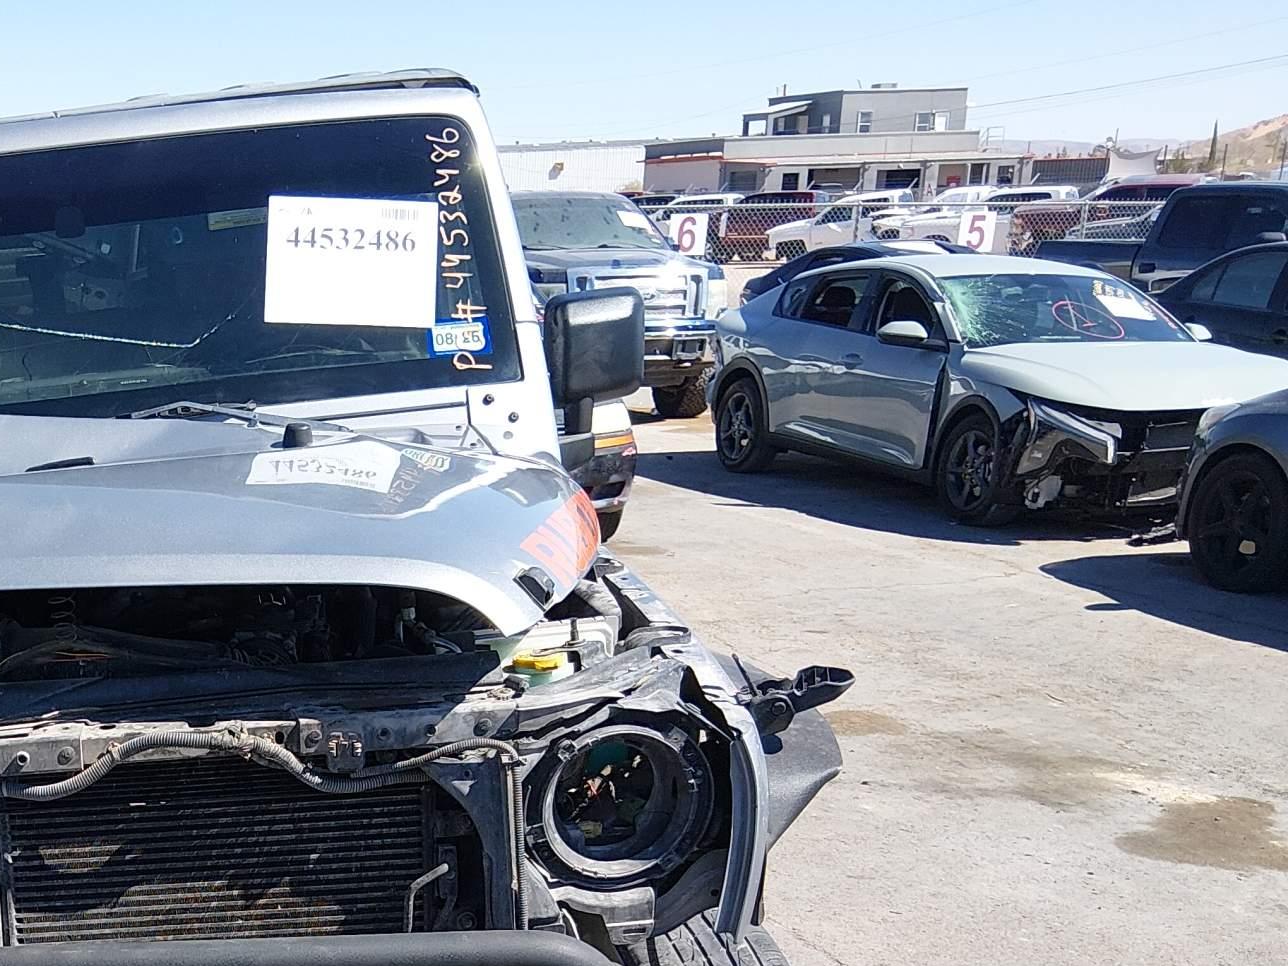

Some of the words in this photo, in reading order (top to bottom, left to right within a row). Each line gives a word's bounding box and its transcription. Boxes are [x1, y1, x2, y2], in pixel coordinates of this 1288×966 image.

[426, 127, 475, 289] 44532486
[285, 226, 417, 252] 44532486
[677, 215, 697, 252] 6
[965, 214, 987, 251] 5
